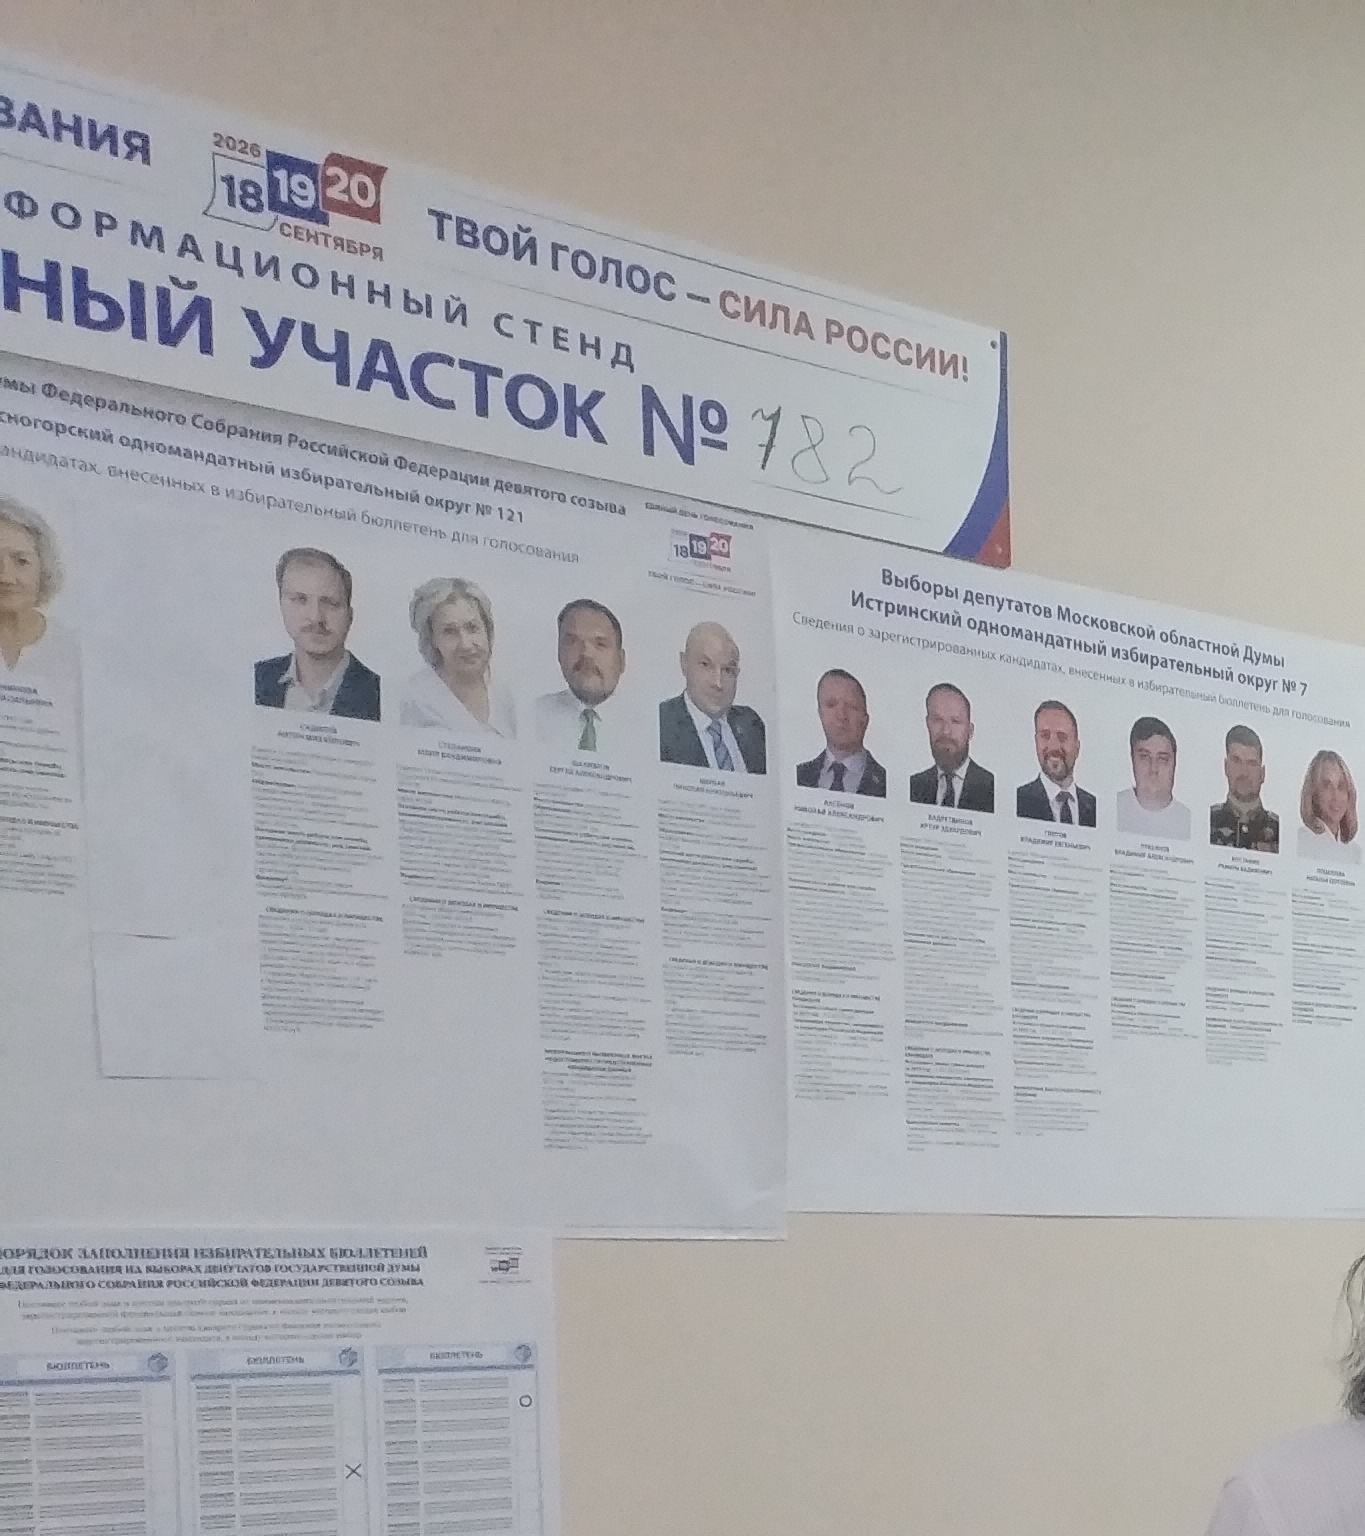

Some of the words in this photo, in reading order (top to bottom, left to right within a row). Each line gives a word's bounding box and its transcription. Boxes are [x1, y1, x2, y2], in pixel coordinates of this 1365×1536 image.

[0, 94, 151, 167] ВАНИЯ
[212, 131, 262, 158] 2026
[220, 173, 265, 213] 18
[271, 168, 317, 209] 19
[323, 166, 377, 209] 20
[3, 190, 468, 328] ФОРМАЦИОННЫЙ
[493, 311, 635, 373] СТЕНД
[278, 222, 384, 262] СЕНТЯБРЯ
[427, 207, 538, 267] ТВОЙ
[550, 242, 677, 302] ГОЛОС
[718, 289, 816, 341] СИЛА
[825, 323, 970, 383] РОССИИ!
[1, 248, 214, 357] НЫЙ
[240, 306, 609, 446] УЧАСТОК
[641, 384, 729, 467] №
[41, 383, 187, 426] Федерального
[191, 413, 284, 447] Собрания
[287, 432, 390, 468] Российской
[393, 455, 490, 490] Федерации
[494, 479, 567, 505] девятого
[570, 494, 627, 517] созыва
[119, 434, 276, 479] одномандатный
[280, 459, 420, 504] избирательный
[424, 494, 472, 517] округ
[475, 503, 493, 519] №
[497, 506, 524, 525] 121
[749, 404, 905, 497] 782
[225, 487, 357, 522] избирательный
[361, 512, 447, 541] бюллетень
[451, 530, 479, 547] для
[482, 536, 580, 564] голосования
[673, 543, 689, 559] 18
[691, 540, 707, 555] 19
[709, 538, 729, 553] 20
[850, 589, 962, 628] Истринский
[966, 615, 1107, 658] одномандатный
[1110, 646, 1235, 684] избирательный
[1237, 672, 1279, 694] округ
[1281, 678, 1298, 695] №
[1299, 682, 1309, 697] 7
[881, 567, 959, 600] Выборы
[962, 589, 1053, 621] депутатов
[1056, 604, 1156, 642] Московской
[1159, 628, 1241, 660] областной
[1242, 644, 1286, 669] Думы
[792, 611, 855, 635] Сведения
[857, 626, 866, 637] о
[868, 624, 997, 662] зарегистрированных
[1068, 665, 1127, 686] внесенных
[1137, 680, 1218, 703] избирательный
[1272, 706, 1291, 718] для
[1291, 709, 1352, 729] голосования
[0, 1247, 73, 1260] ОРЯДОК
